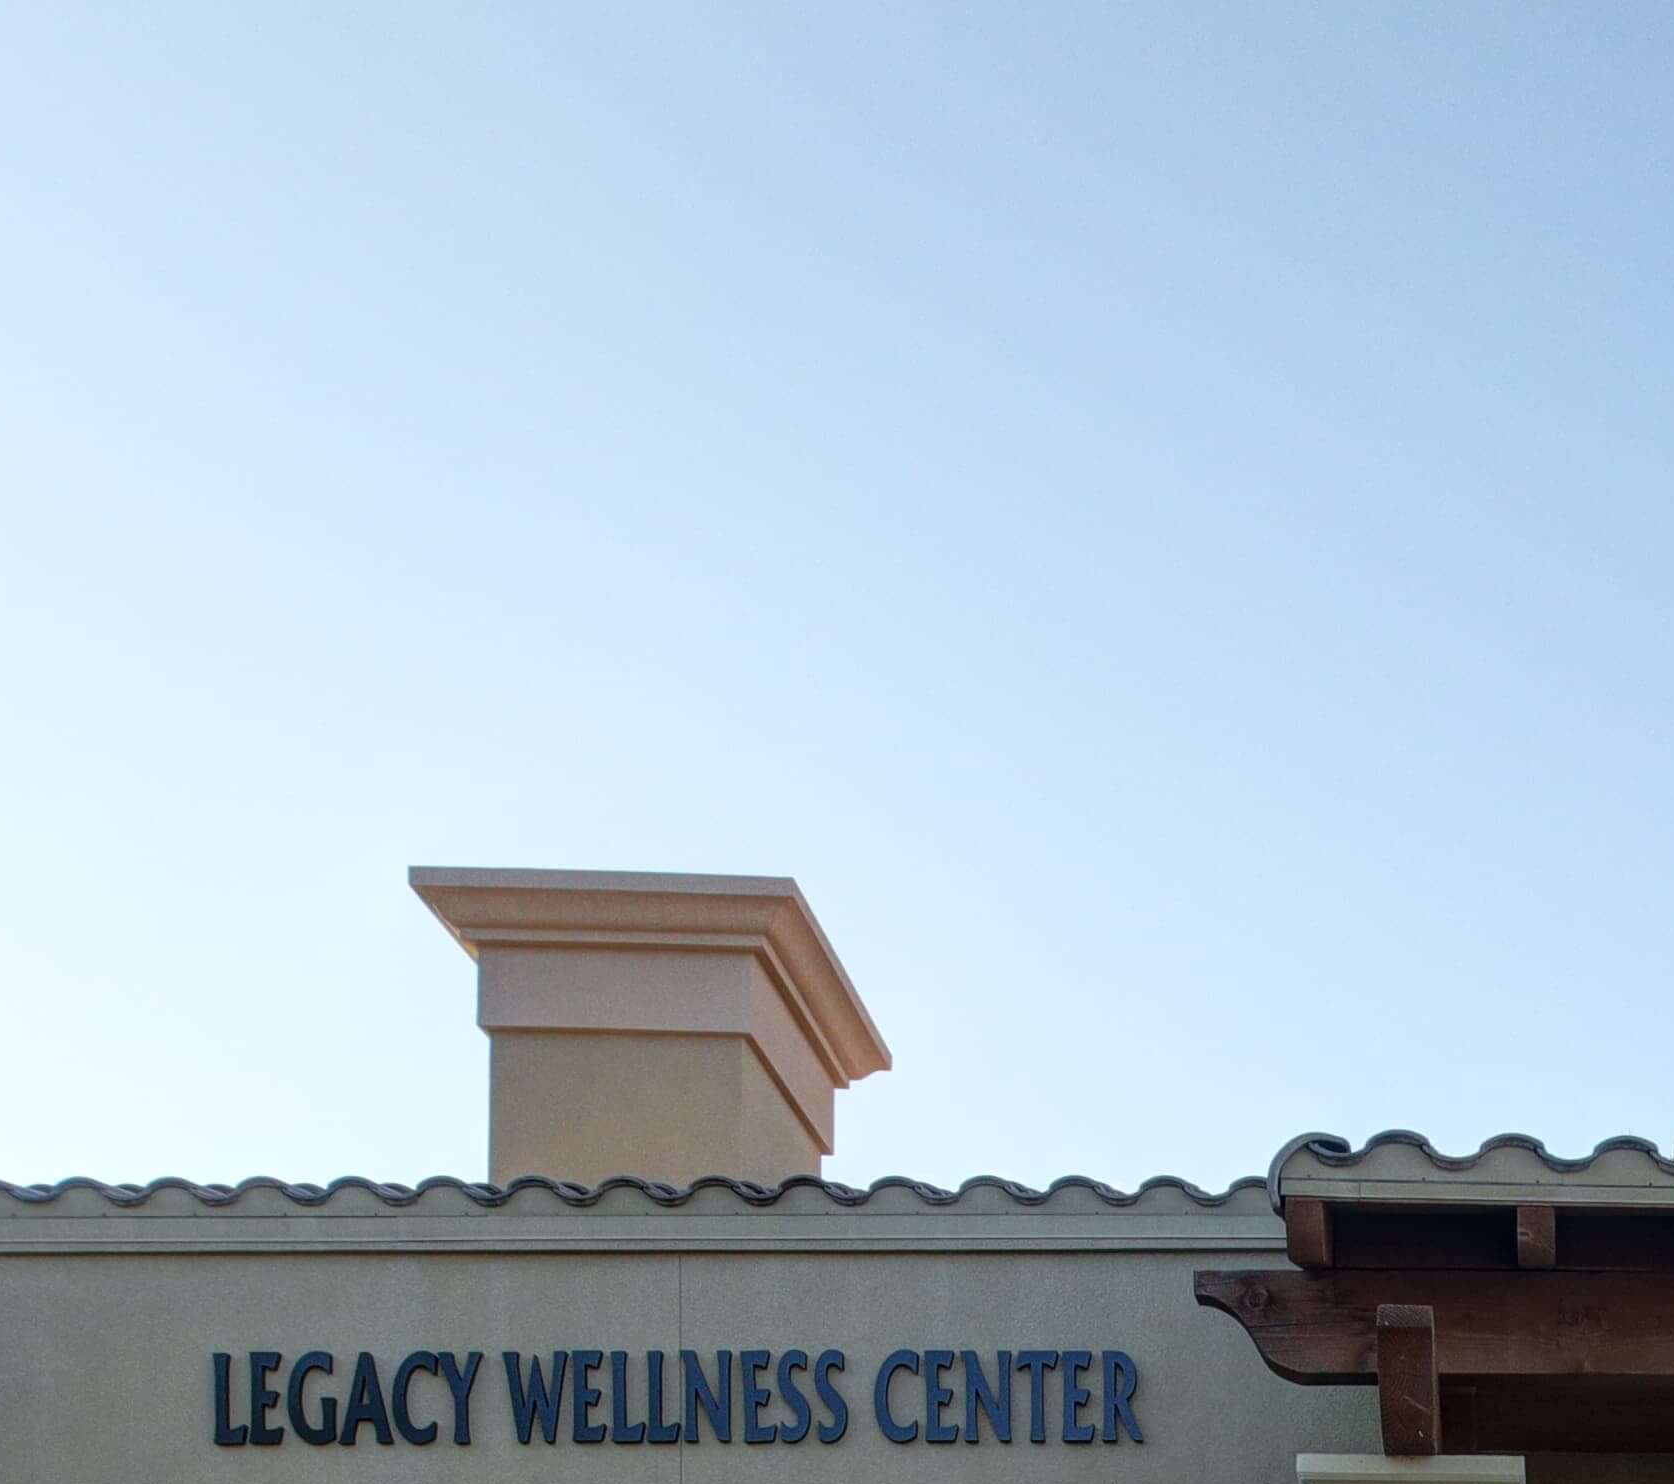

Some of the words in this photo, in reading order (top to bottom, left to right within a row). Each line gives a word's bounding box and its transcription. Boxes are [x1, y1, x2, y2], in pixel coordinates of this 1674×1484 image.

[212, 1350, 484, 1446] LEGACY
[502, 1349, 848, 1445] WELLNESS
[874, 1349, 1144, 1444] CENTER
